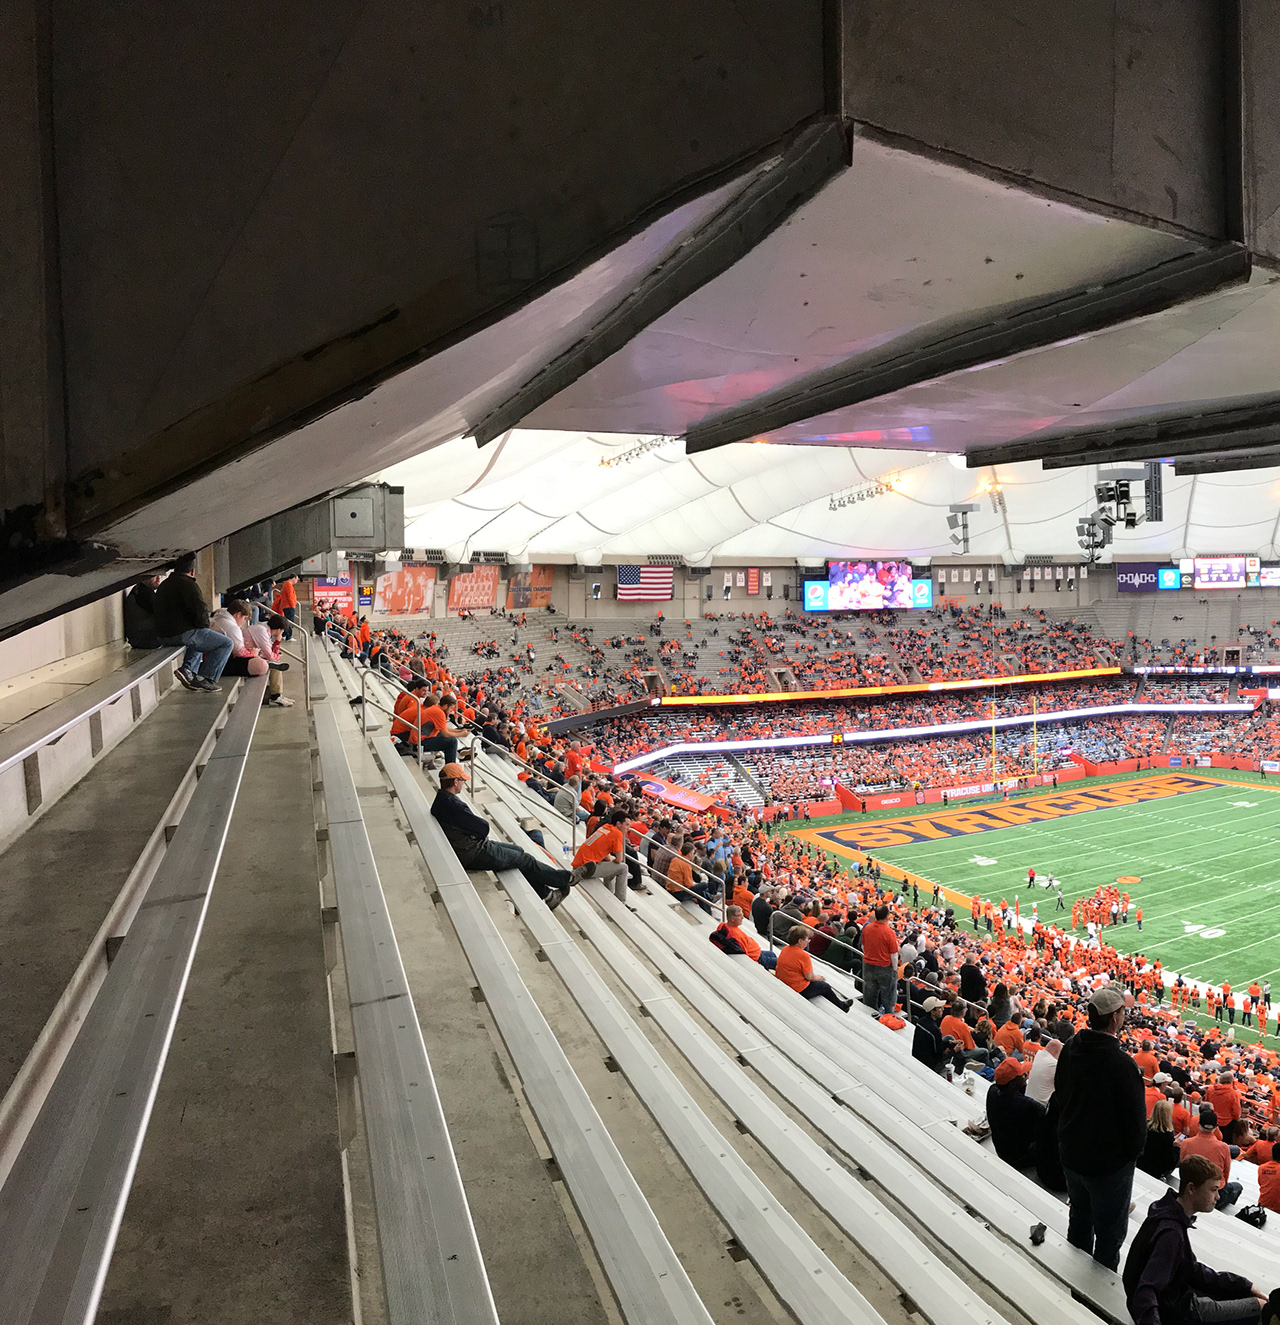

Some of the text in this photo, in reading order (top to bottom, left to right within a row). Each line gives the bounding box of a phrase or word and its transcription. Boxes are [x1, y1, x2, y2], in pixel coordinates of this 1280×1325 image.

[832, 734, 843, 743] 25
[833, 777, 1217, 848] SYRACUSE
[1184, 923, 1227, 939] 40
